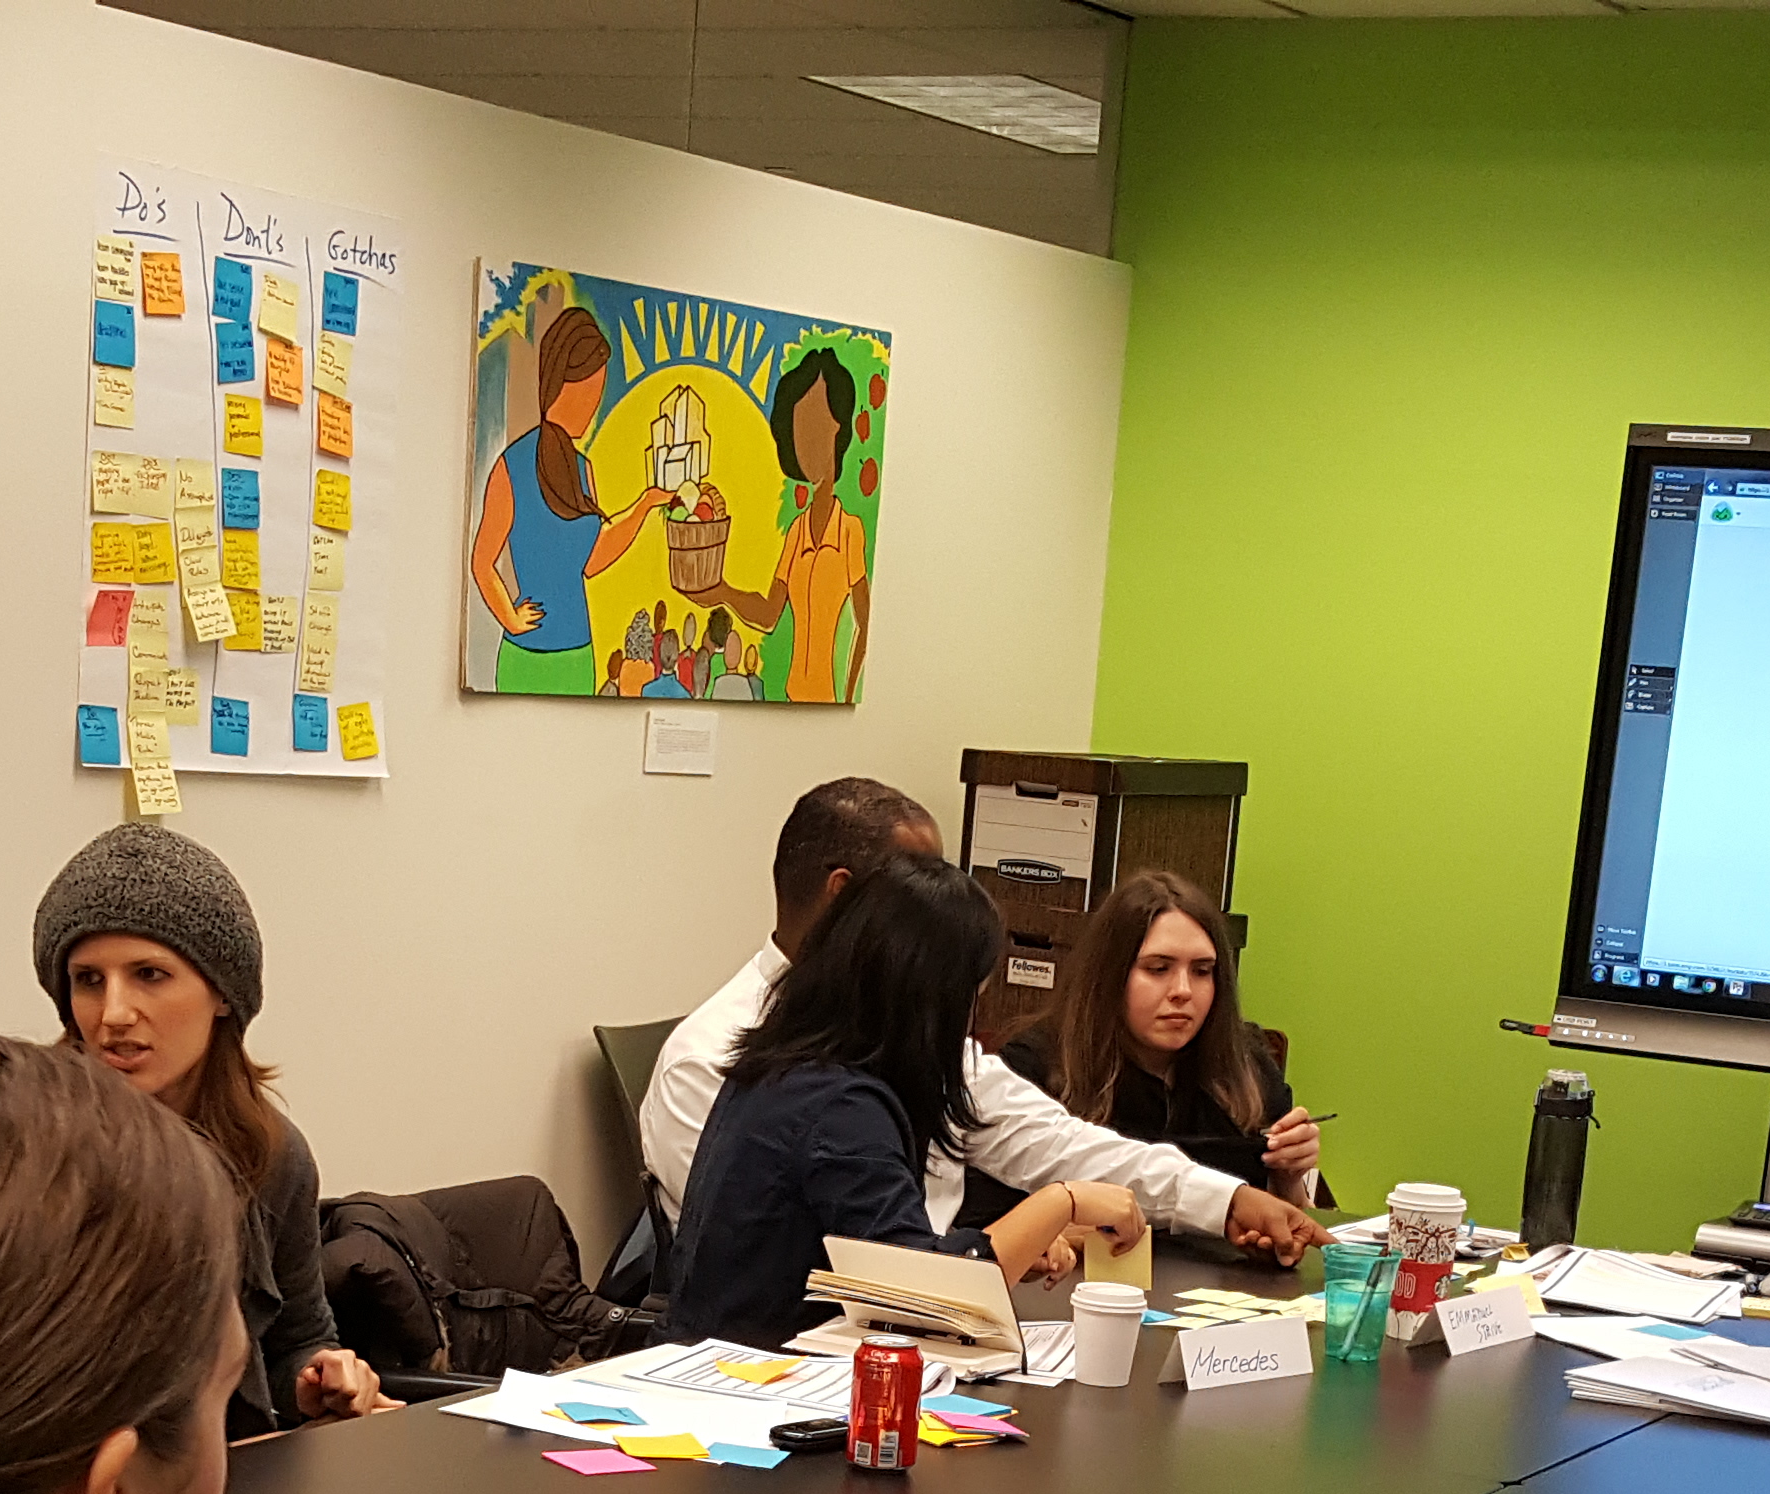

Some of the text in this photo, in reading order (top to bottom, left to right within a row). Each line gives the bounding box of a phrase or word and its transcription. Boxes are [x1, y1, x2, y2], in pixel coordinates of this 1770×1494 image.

[116, 171, 166, 223] Do's
[221, 192, 284, 255] Dont's
[328, 231, 396, 274] Gotchas
[1001, 865, 1059, 879] BANKERS BOX
[1012, 959, 1049, 973] Fellowes
[1191, 1346, 1279, 1378] Mercedes
